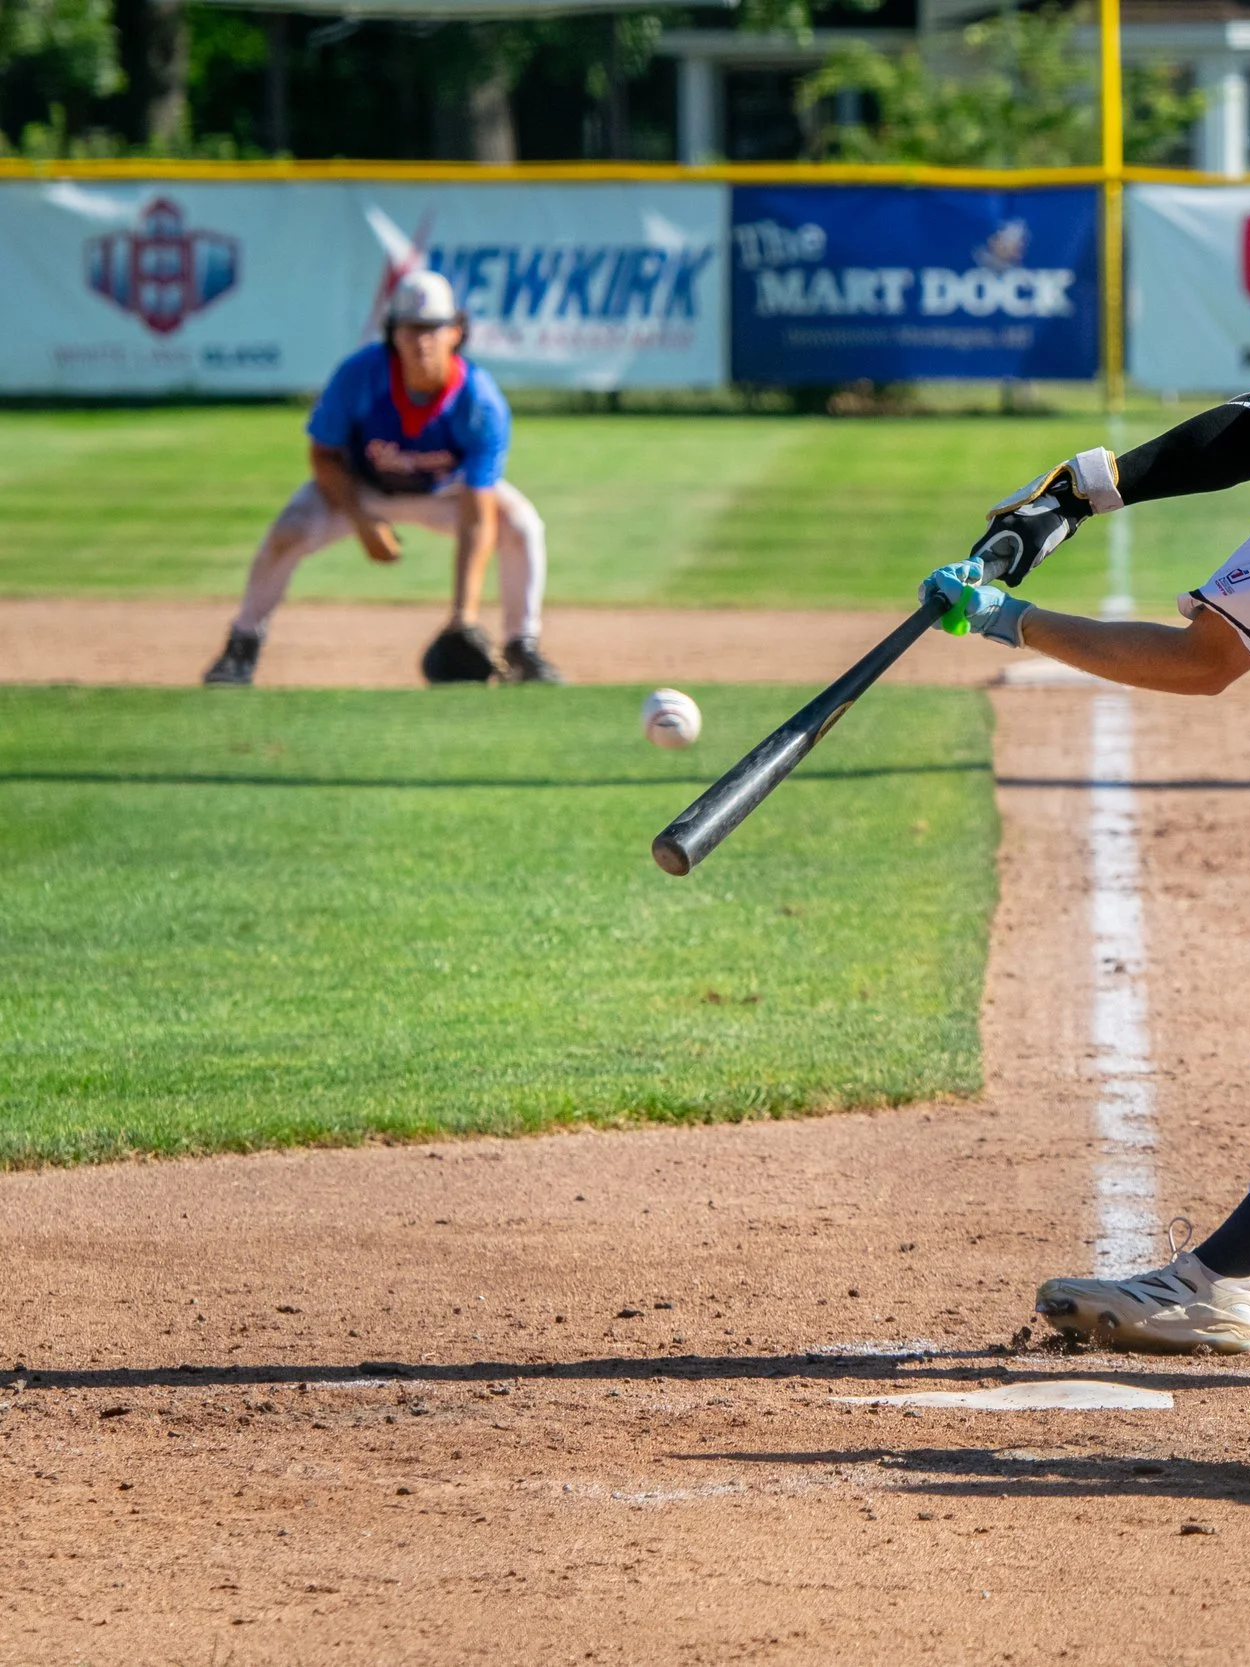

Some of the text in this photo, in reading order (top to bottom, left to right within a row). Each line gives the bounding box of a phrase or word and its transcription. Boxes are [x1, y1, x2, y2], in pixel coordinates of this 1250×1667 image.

[733, 219, 827, 269] The
[756, 267, 1075, 317] MART DOCK
